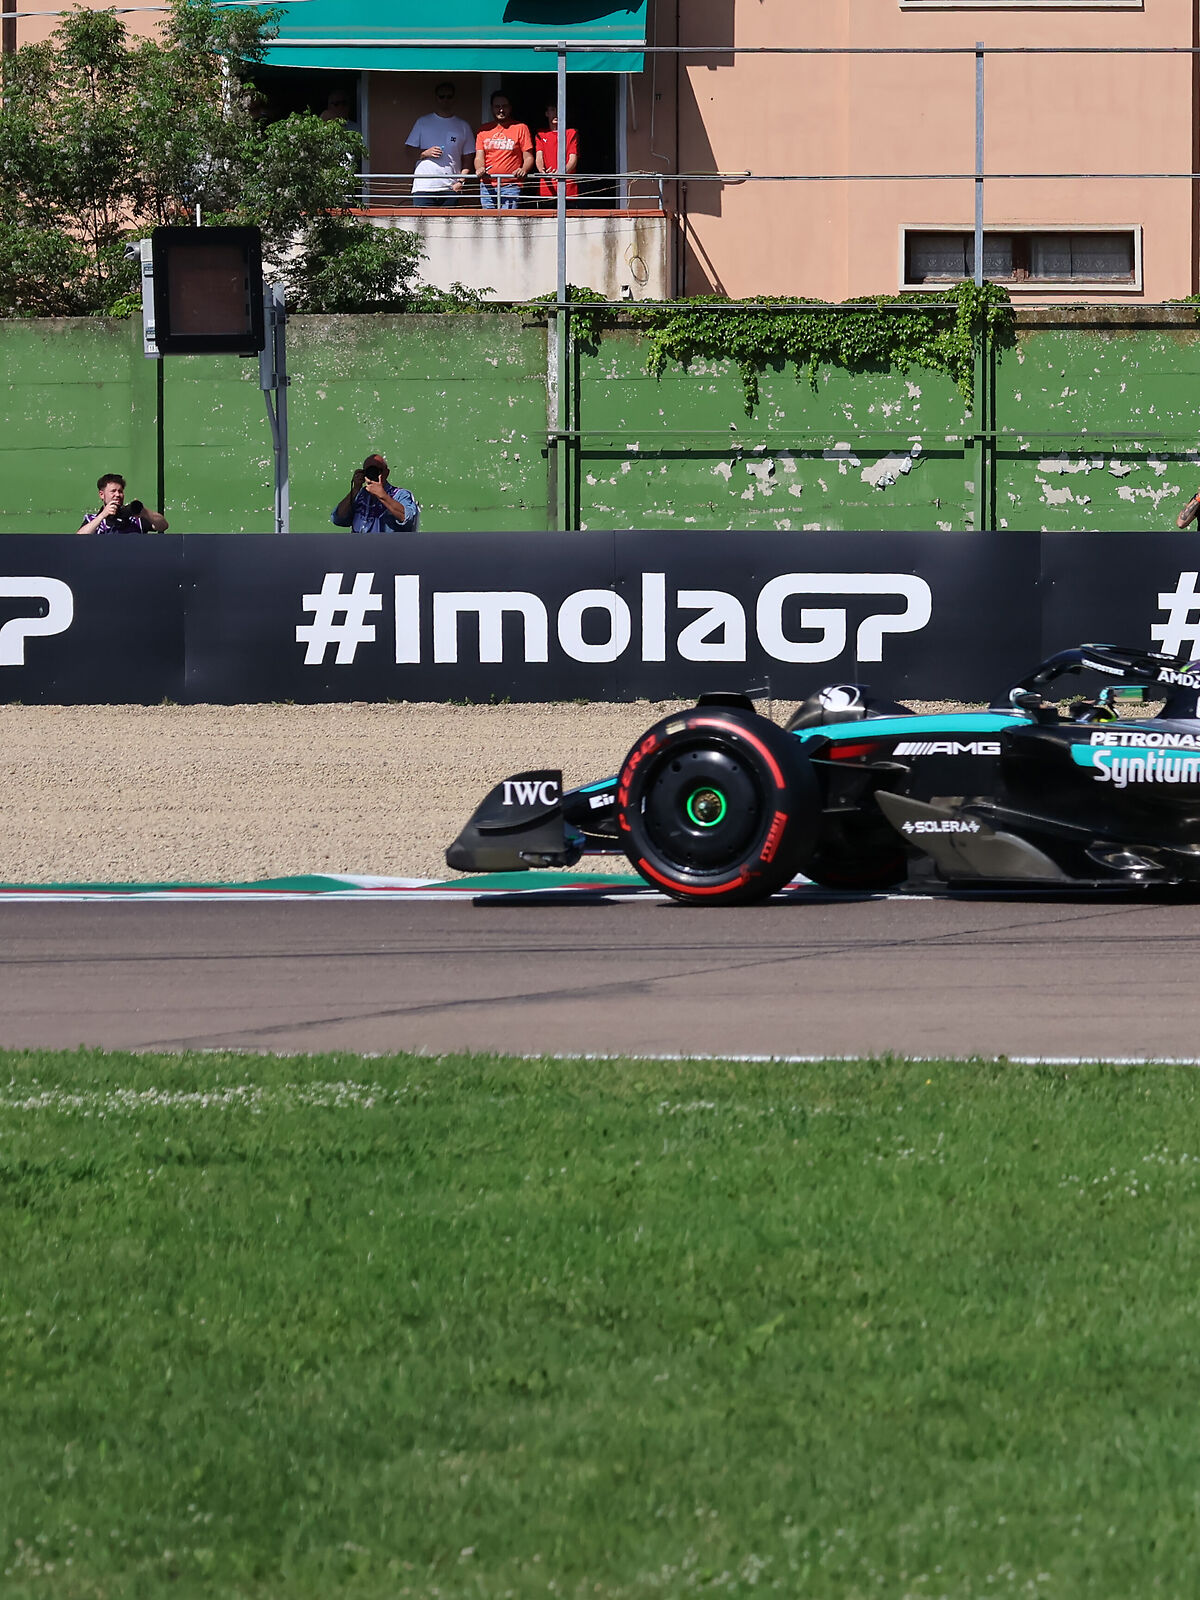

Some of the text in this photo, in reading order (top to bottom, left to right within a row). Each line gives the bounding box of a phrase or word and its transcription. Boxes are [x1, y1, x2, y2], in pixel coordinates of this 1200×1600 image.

[295, 572, 932, 664] #ImolaGP
[1157, 670, 1195, 687] AMD
[926, 741, 1001, 756] AMG
[501, 780, 559, 806] IWC
[913, 820, 972, 833] SOLERA
